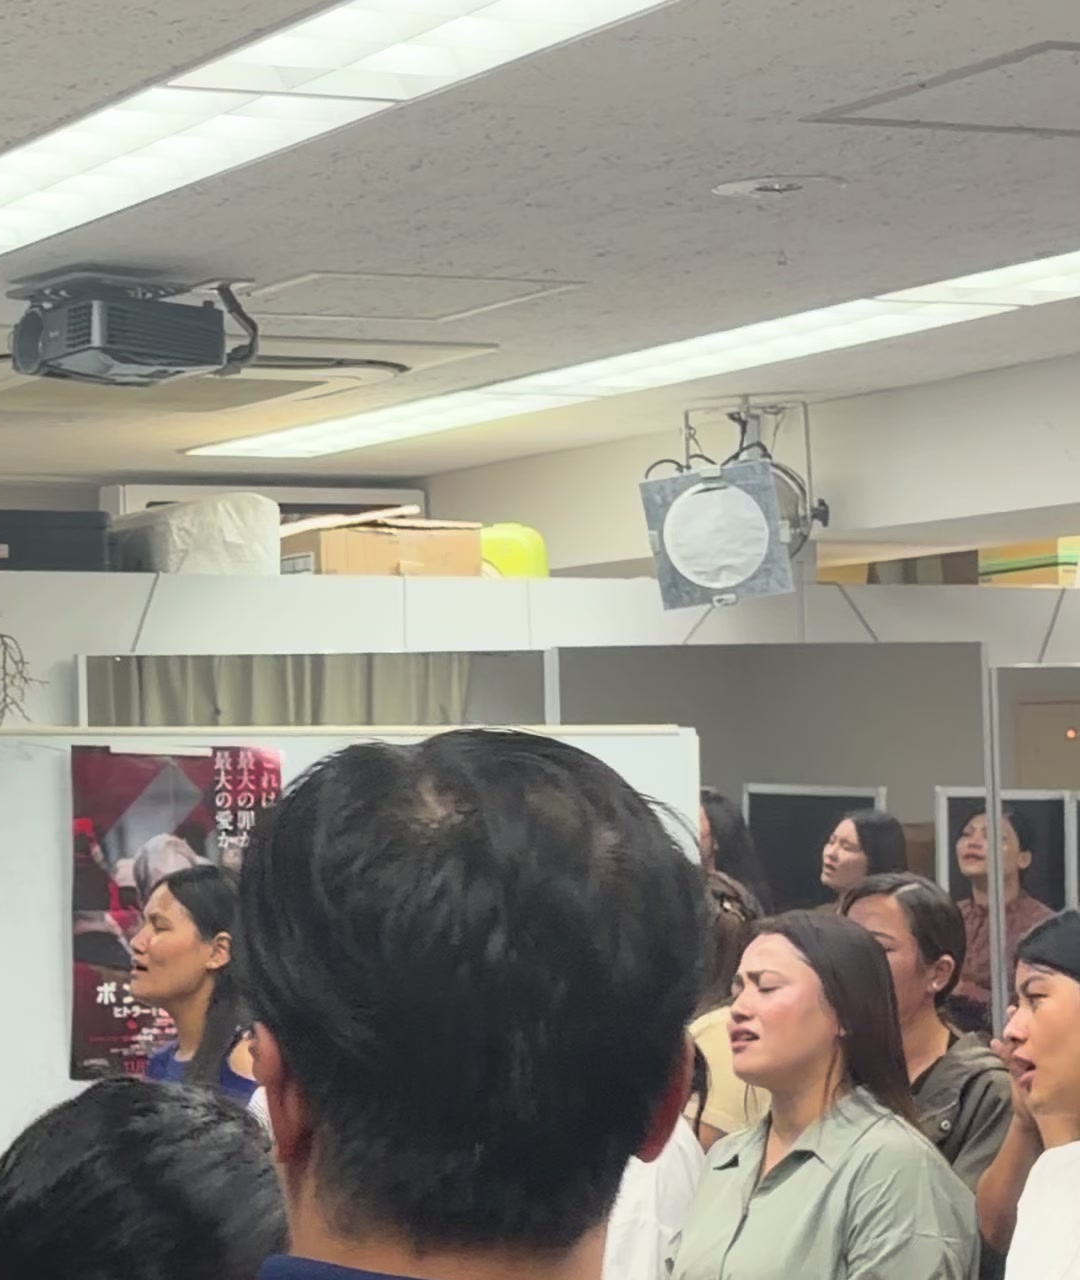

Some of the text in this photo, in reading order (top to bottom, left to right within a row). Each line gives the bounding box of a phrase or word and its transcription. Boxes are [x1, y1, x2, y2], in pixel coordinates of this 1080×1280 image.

[214, 751, 234, 848] 最大の愛か
